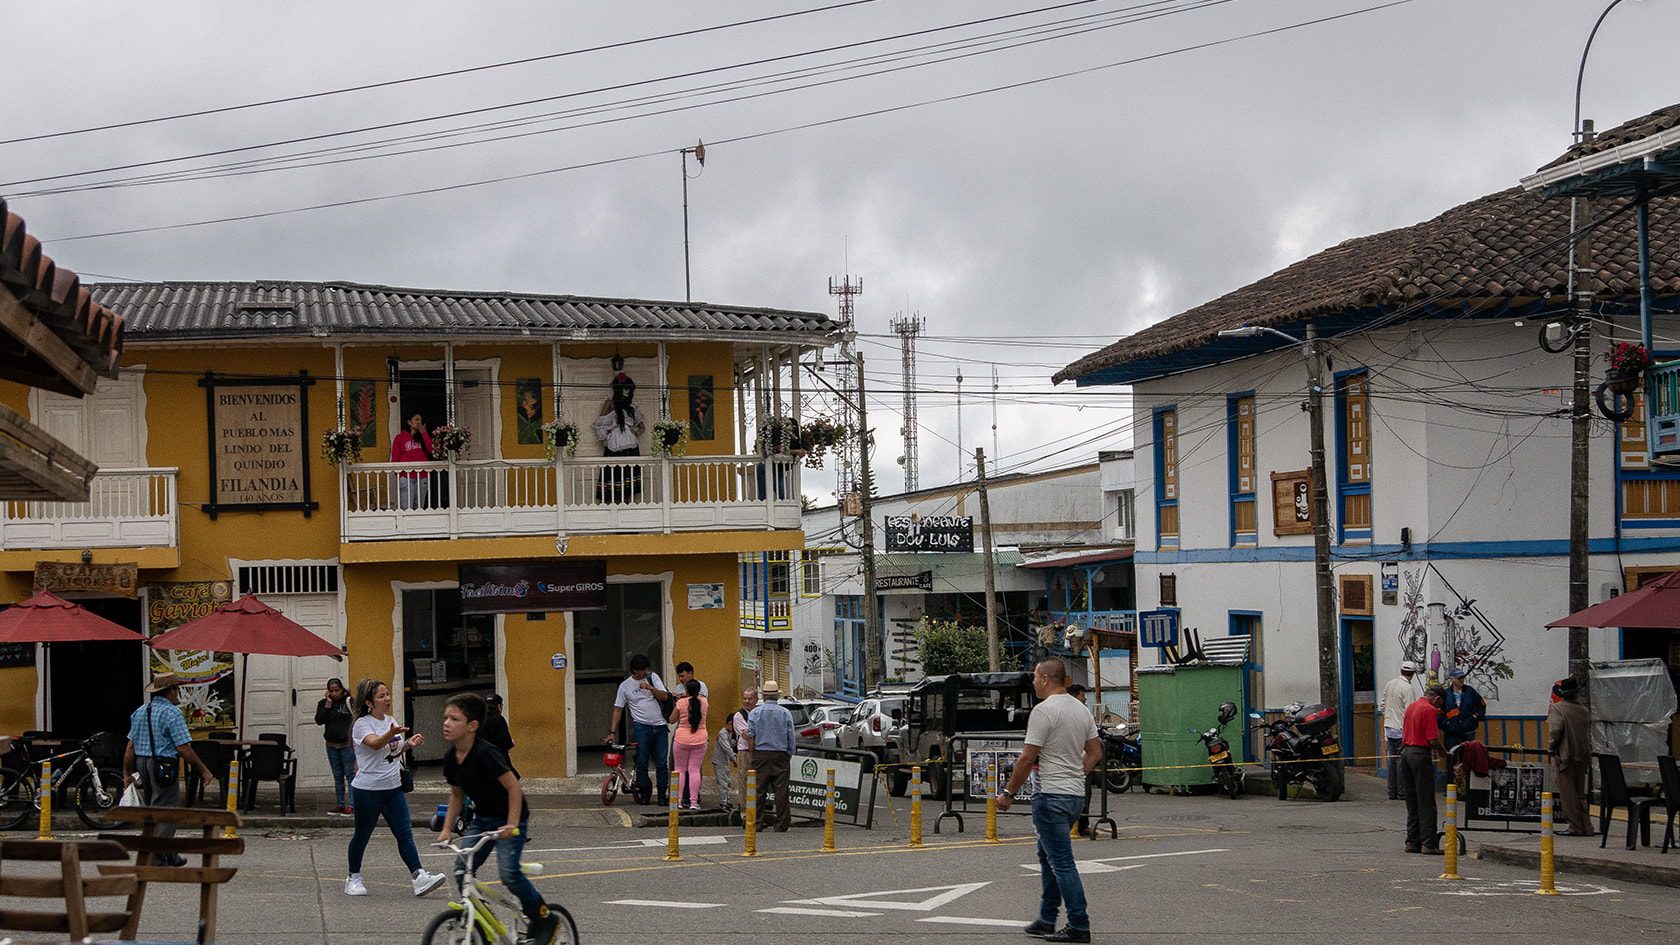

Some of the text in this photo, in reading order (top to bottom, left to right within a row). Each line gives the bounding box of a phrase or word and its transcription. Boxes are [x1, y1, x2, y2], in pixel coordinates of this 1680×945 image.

[219, 393, 296, 406] BIENVENIDOS
[250, 412, 267, 421] AL
[222, 427, 295, 438] PUEBLO MAS
[224, 444, 293, 454] LINDO DEL
[233, 460, 285, 471] QUINDIO
[220, 478, 299, 492] FILANDIA
[240, 495, 254, 503] 140
[929, 533, 960, 547] LUIS
[875, 576, 920, 588] RESTAURANTE
[170, 583, 210, 601] Café
[151, 600, 231, 624] Gaviot
